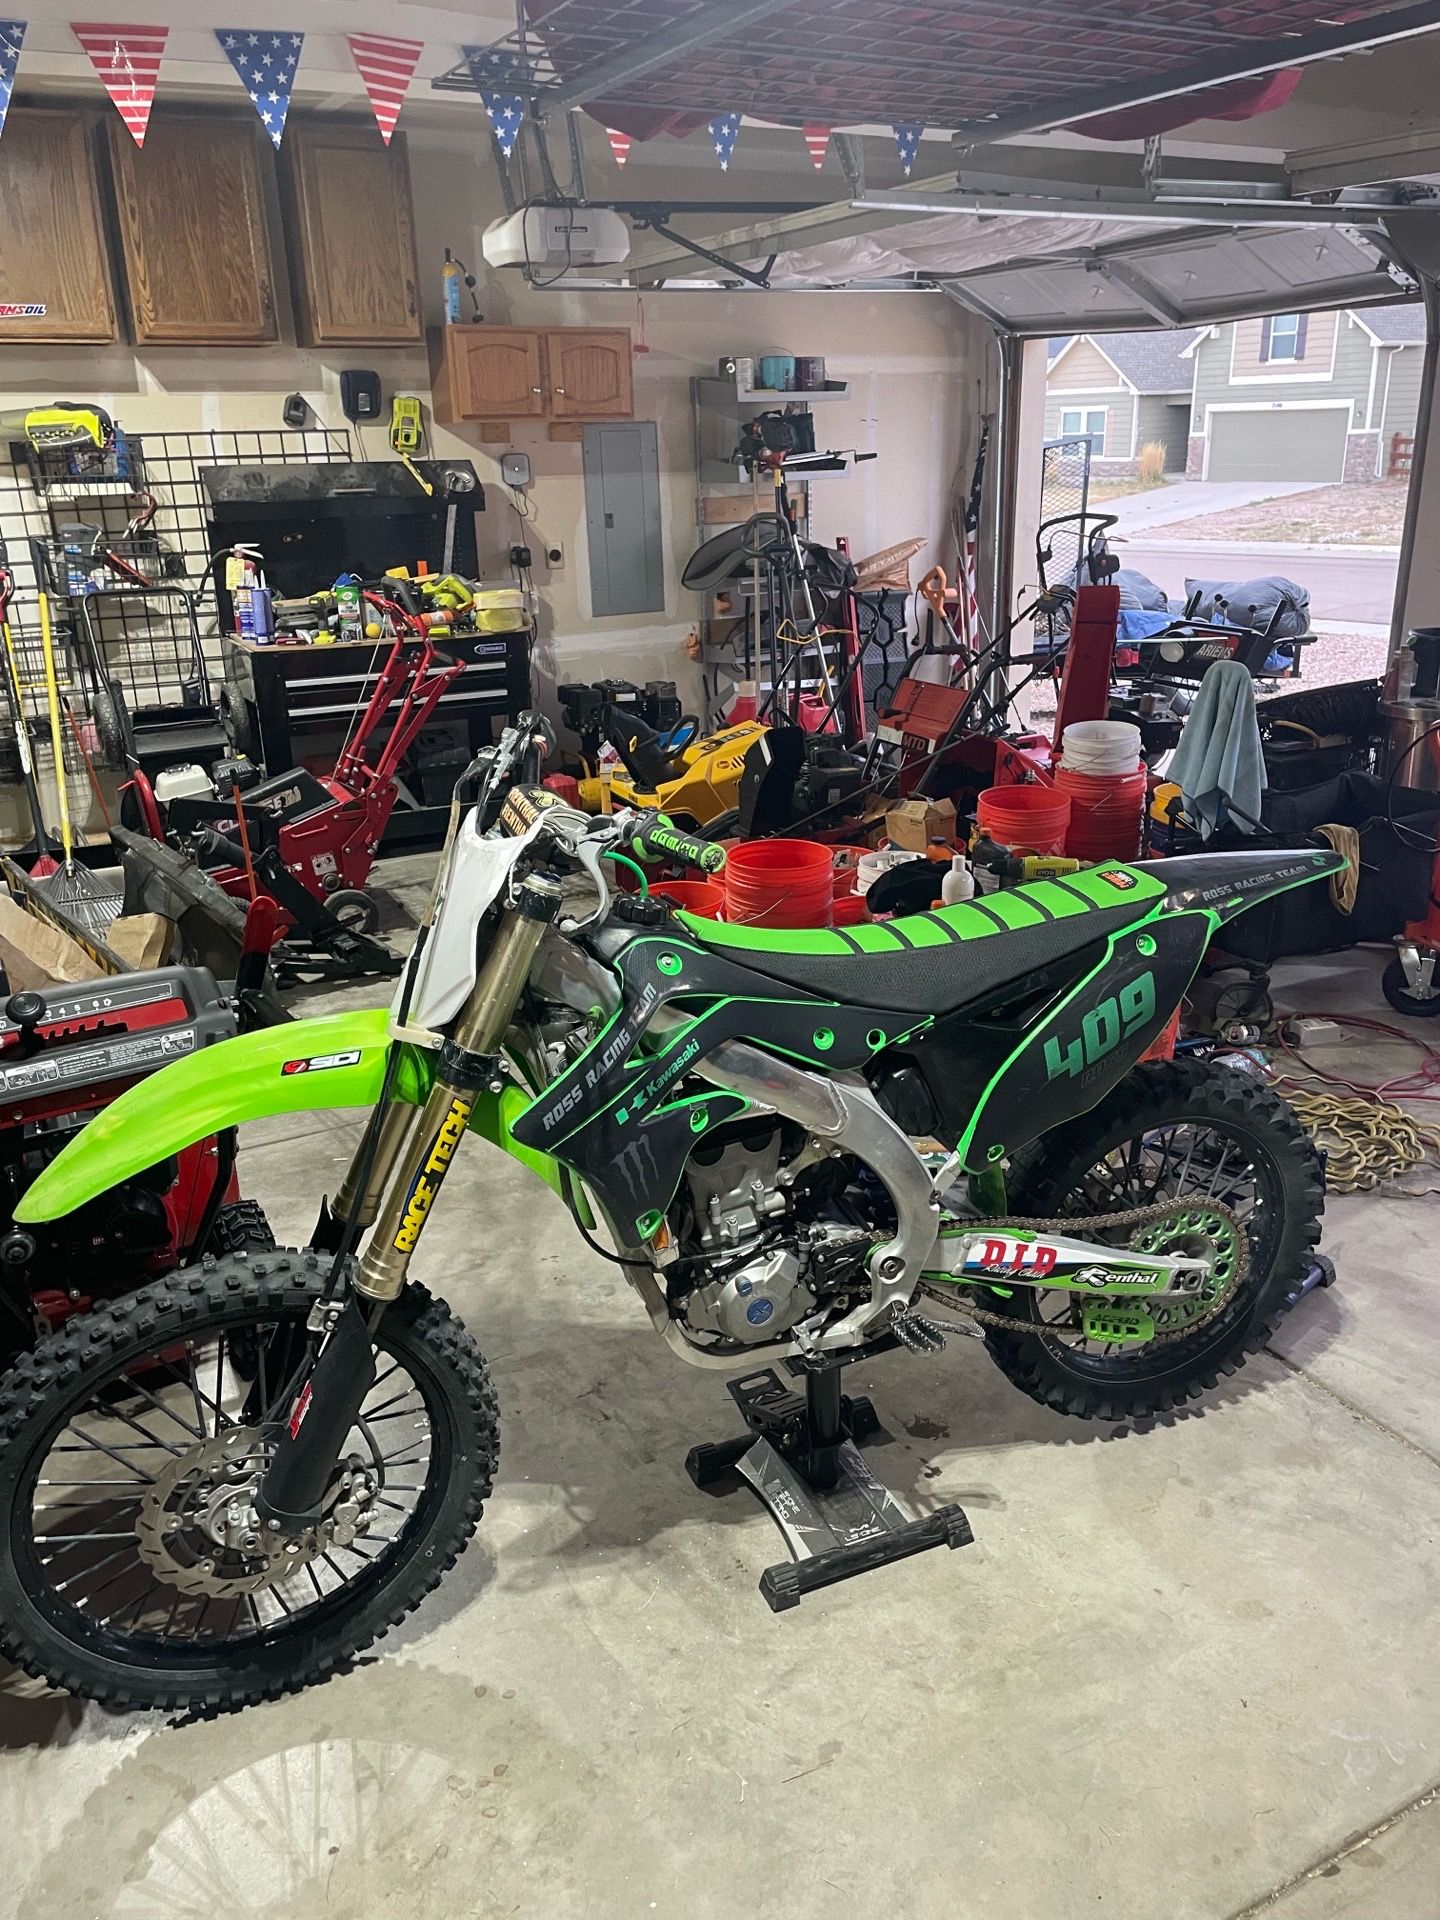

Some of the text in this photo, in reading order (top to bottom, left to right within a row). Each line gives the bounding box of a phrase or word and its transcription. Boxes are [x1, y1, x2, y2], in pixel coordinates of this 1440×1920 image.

[1196, 643, 1234, 660] ARIENS
[903, 733, 927, 751] MTD
[501, 803, 528, 836] RENTHA
[1202, 865, 1309, 901] ROSS RACING TEAM
[1043, 970, 1156, 1081] 409
[542, 982, 657, 1132] ROSS RACING TEAM
[646, 1038, 701, 1097] Kawasaki
[393, 1097, 472, 1254] RACE TECH
[981, 1263, 1018, 1279] Racing
[1073, 1266, 1158, 1287] Renthal
